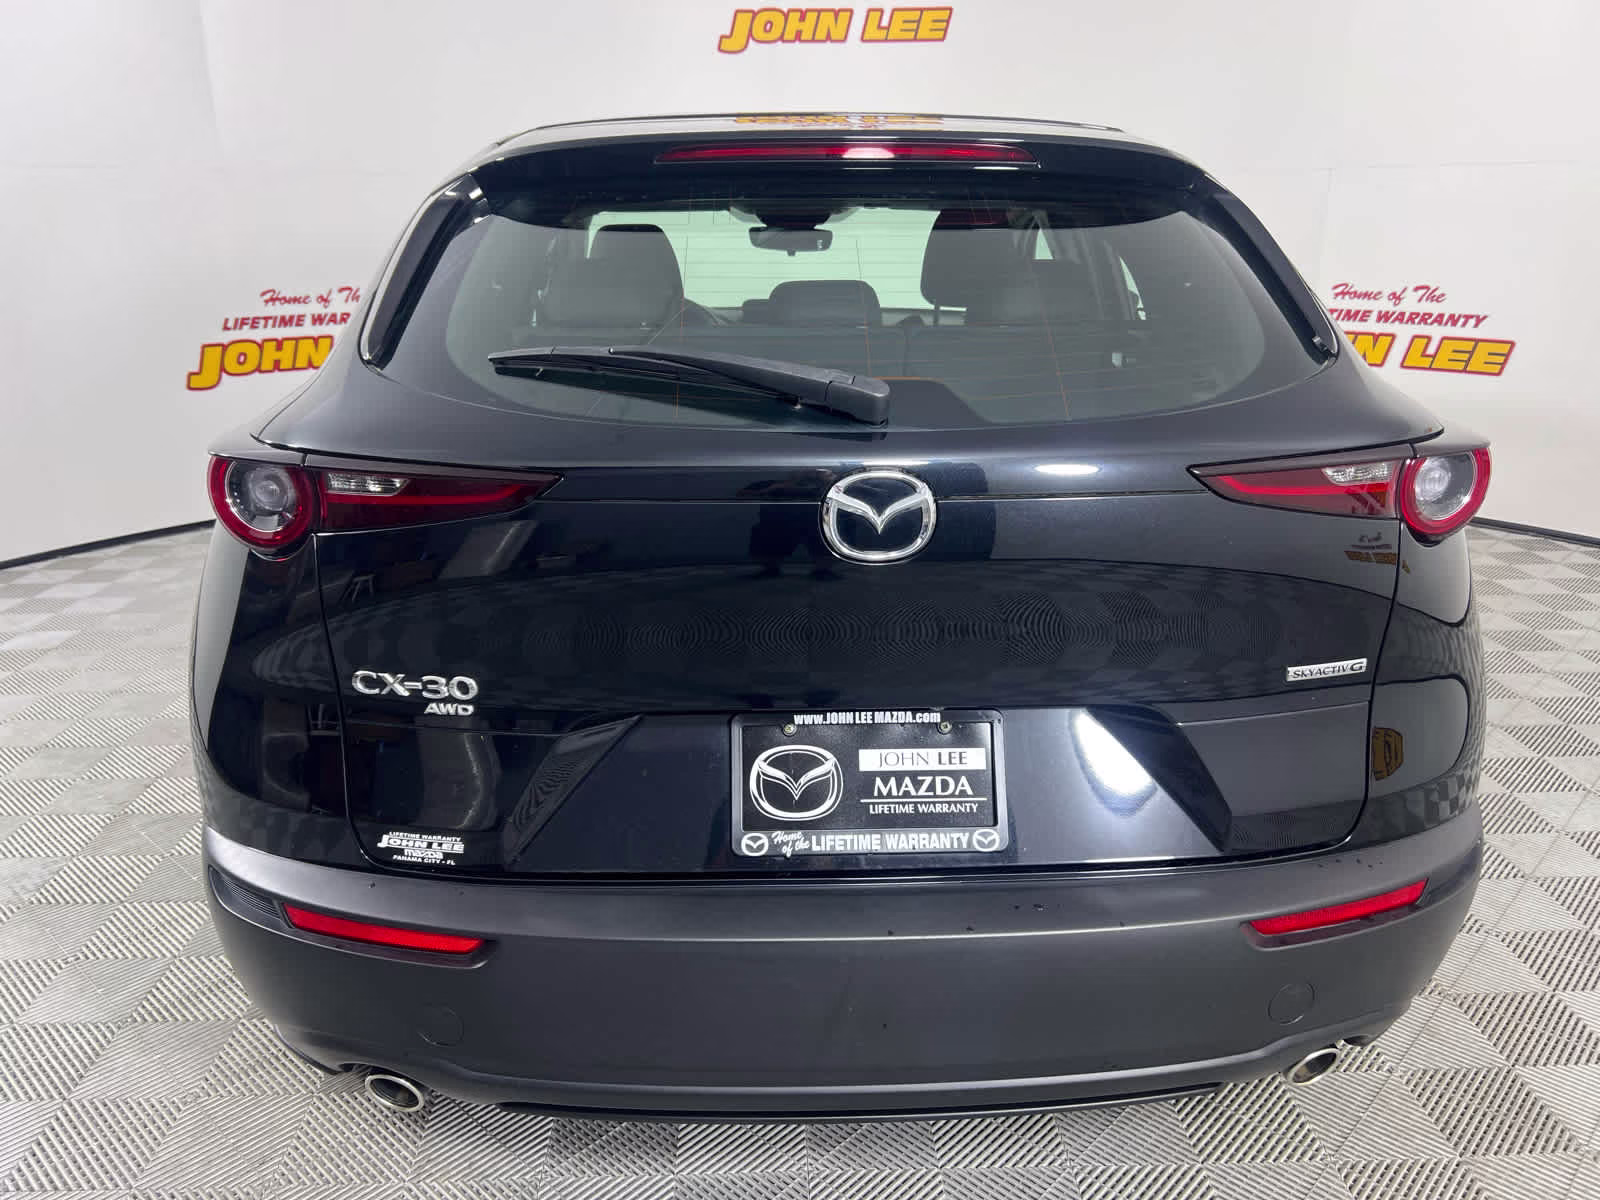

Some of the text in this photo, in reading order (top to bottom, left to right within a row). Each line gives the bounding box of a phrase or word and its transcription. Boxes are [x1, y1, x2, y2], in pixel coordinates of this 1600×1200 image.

[718, 7, 952, 53] JOHN LEE
[260, 288, 311, 307] Home
[316, 289, 332, 308] of
[1332, 283, 1447, 306] Home of The
[222, 314, 306, 331] LIFETIME
[1376, 310, 1488, 328] WARRANTY
[186, 334, 334, 391] JOHN
[1400, 334, 1516, 376] LEE
[351, 670, 478, 700] CX-30
[424, 703, 474, 716] AWD
[879, 751, 968, 767] JOHN LEE
[873, 775, 974, 796] MAZDA
[869, 802, 978, 815] LIFETIME WARRANTY
[377, 834, 464, 852] JOHN LEE
[389, 831, 461, 842] LIFETIME WARRANTY
[771, 830, 802, 844] Home
[811, 832, 969, 851] LIFETIME WARRANTY
[782, 839, 811, 858] of the
[393, 855, 422, 863] PANAMA
